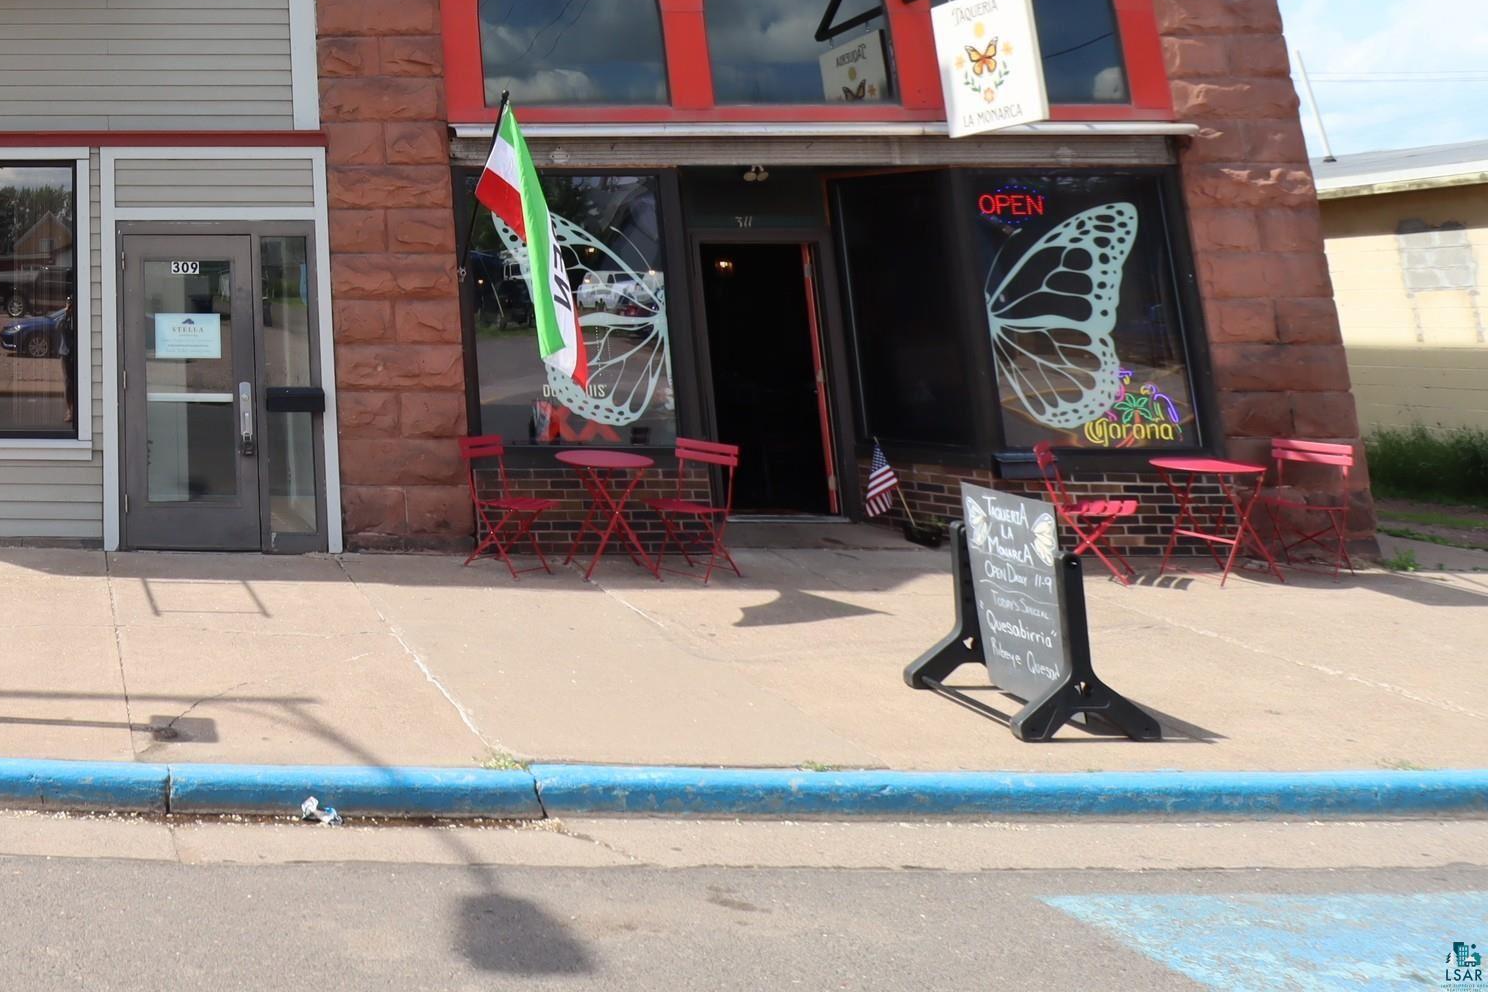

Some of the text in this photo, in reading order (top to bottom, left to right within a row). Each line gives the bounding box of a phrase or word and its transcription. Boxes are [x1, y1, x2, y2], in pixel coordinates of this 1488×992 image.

[952, 0, 998, 26] TAQUERIA
[963, 104, 1023, 128] LA MONARCA
[978, 194, 1044, 215] OPEN
[735, 215, 752, 228] 311
[172, 262, 198, 273] 309
[1084, 417, 1174, 447] Corona
[1001, 524, 1014, 540] LA
